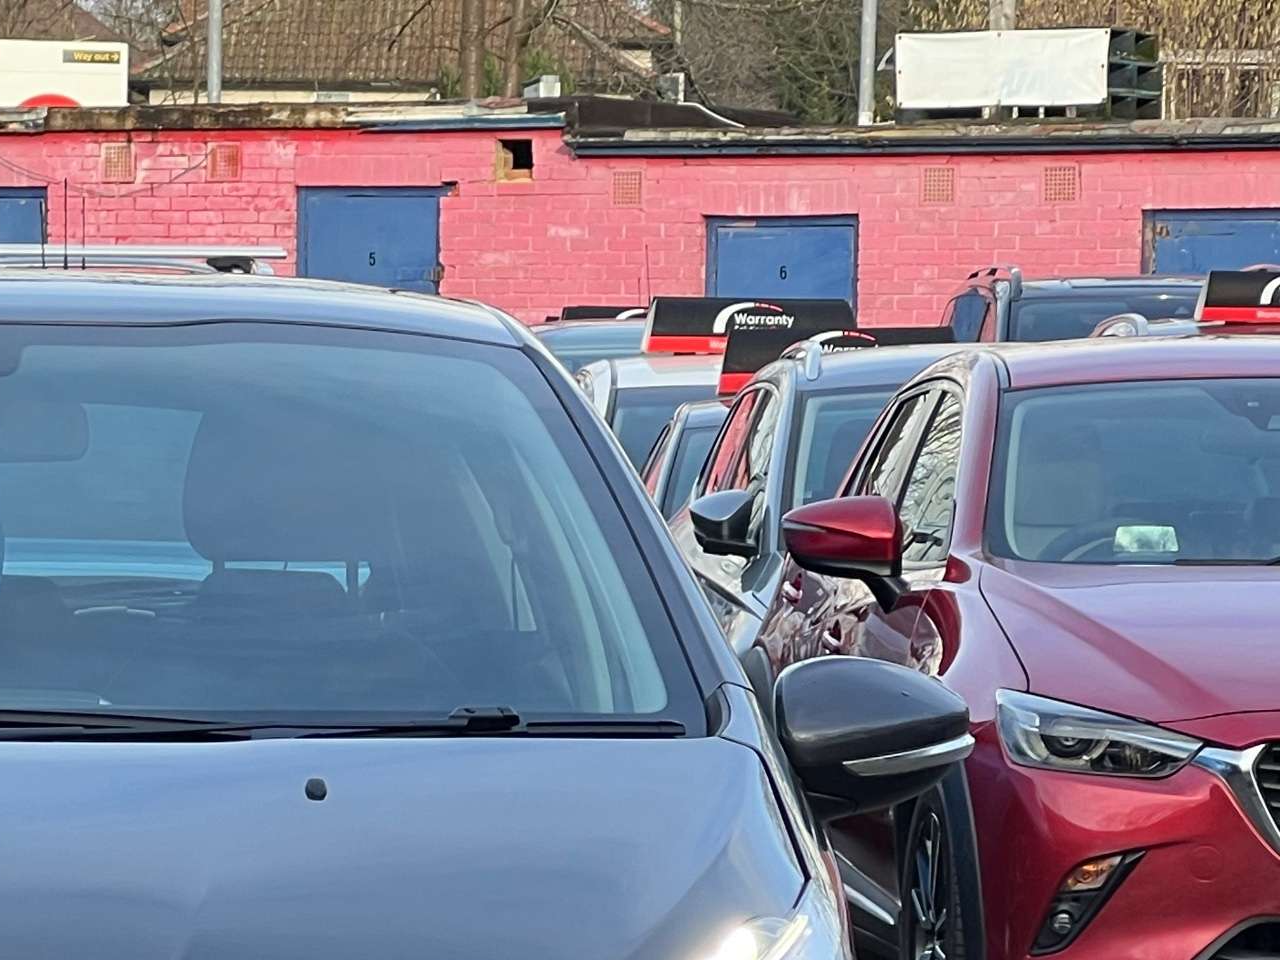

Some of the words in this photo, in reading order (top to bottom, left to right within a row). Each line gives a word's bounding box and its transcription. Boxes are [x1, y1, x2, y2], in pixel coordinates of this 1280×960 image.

[73, 51, 93, 62] Way
[94, 53, 110, 61] out
[368, 252, 376, 266] 5
[779, 265, 787, 280] 6
[734, 313, 794, 328] Warranty
